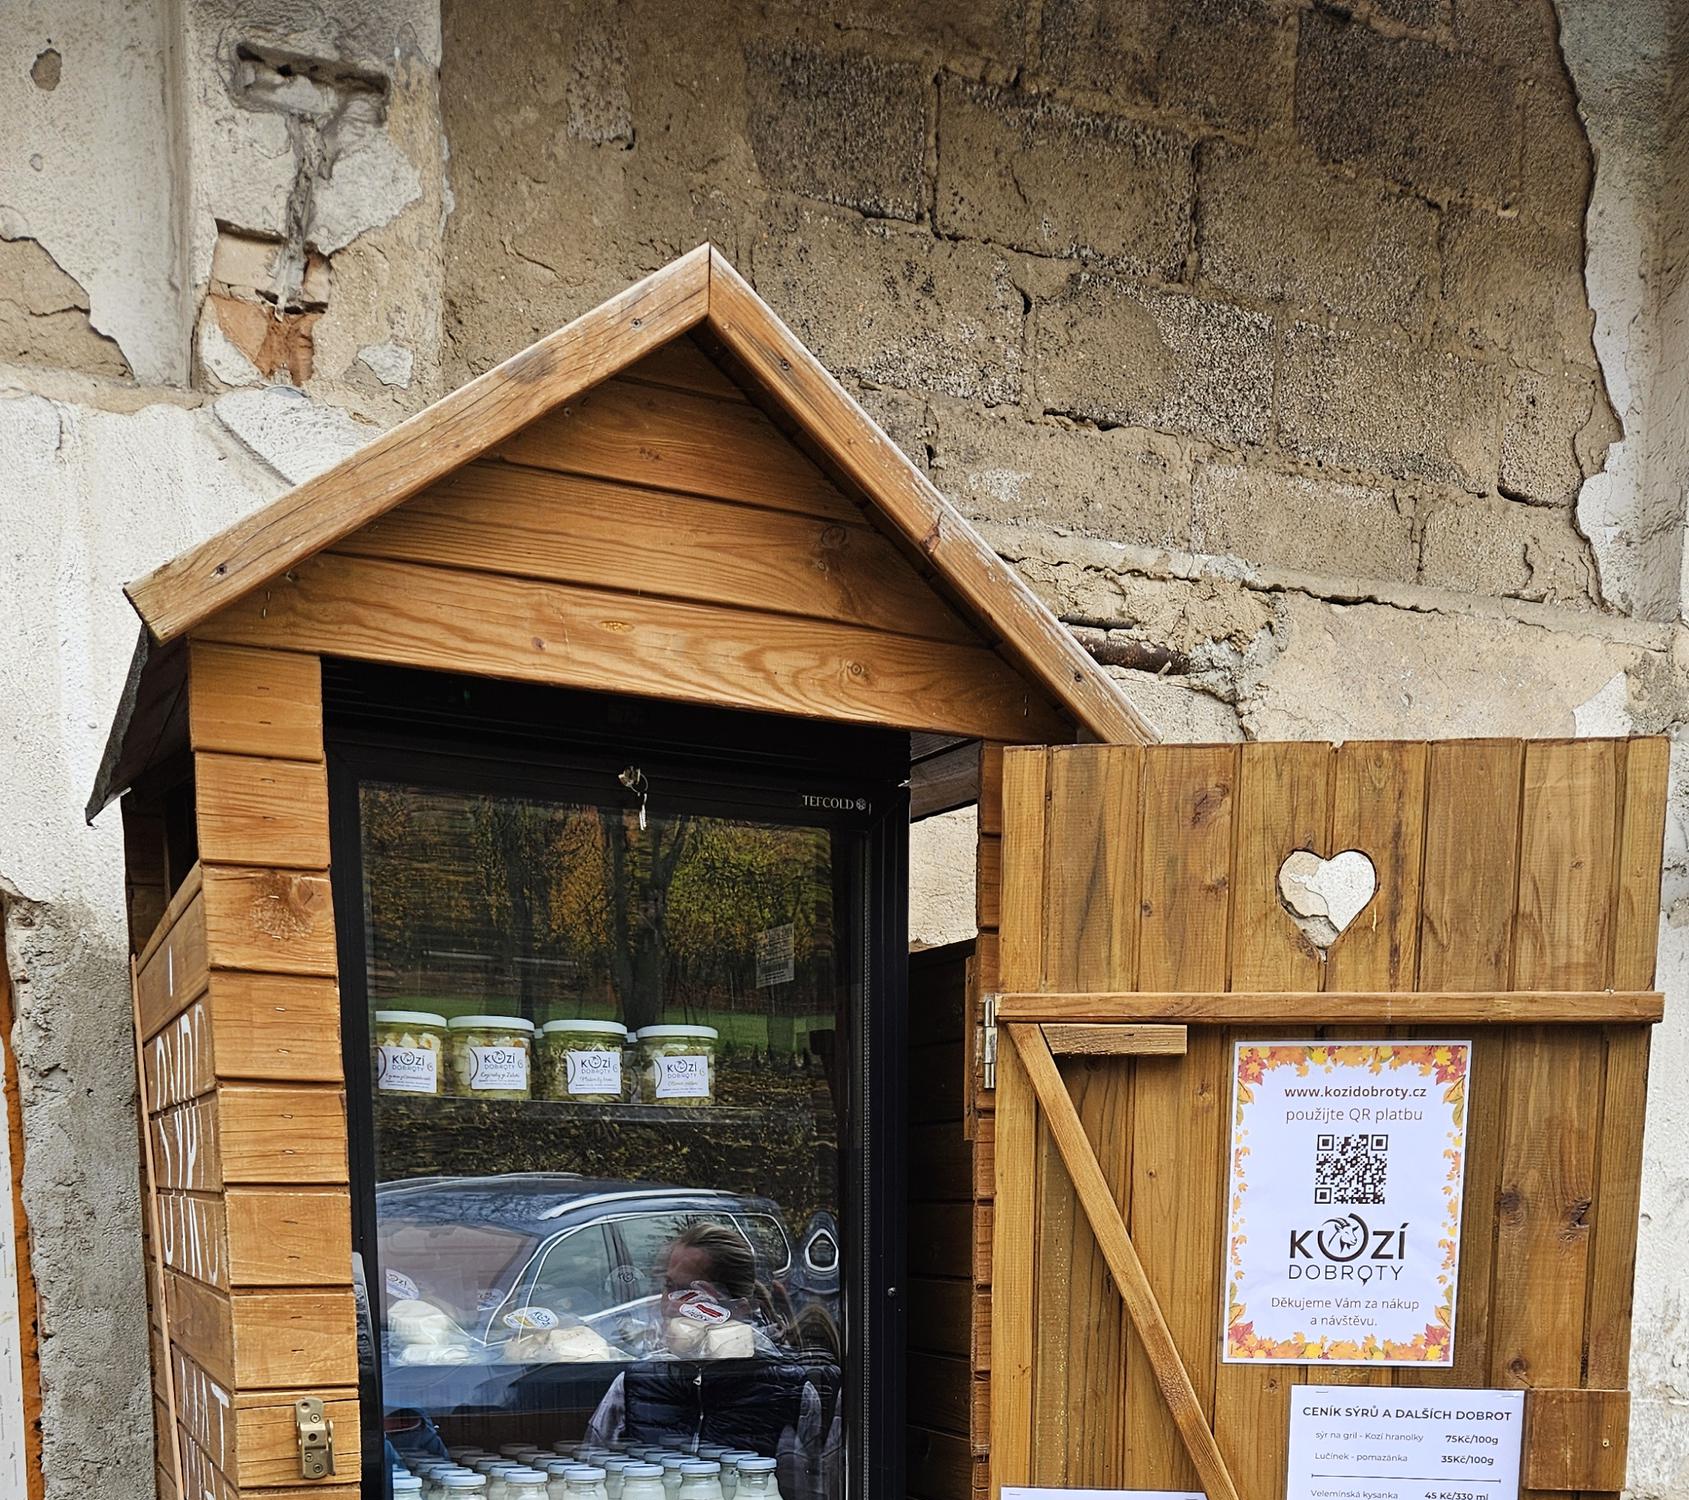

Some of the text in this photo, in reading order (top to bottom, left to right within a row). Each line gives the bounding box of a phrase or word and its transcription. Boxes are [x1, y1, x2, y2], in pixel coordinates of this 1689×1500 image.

[802, 794, 853, 810] TEFCOLD
[393, 1051, 424, 1066] KOZÍ
[484, 1050, 515, 1064] KOZÍ
[581, 1055, 610, 1068] KOZÍ
[667, 1059, 697, 1073] KOZÍ
[1284, 1086, 1427, 1099] www.kozidobroty.cz
[1285, 1108, 1423, 1124] použijte QR platbu
[1289, 1213, 1409, 1263] KOZÍ
[1288, 1265, 1404, 1286] DOBROTY
[1271, 1297, 1419, 1312] Děkujeme Vám za nákup
[1310, 1314, 1377, 1327] a návštěvu.
[1303, 1405, 1512, 1421] CENÍK SÝRŮ A DALŠÍCH DOBROT
[1316, 1432, 1328, 1441] sýr
[1343, 1432, 1358, 1441] gril
[1365, 1432, 1383, 1440] Kozí
[1385, 1433, 1424, 1443] hranolky
[1446, 1434, 1498, 1445] 75Kč/100g
[1315, 1452, 1494, 1466] Lučínek pomazánka 35Kč/100g
[1363, 1492, 1398, 1500] kysanka
[1425, 1492, 1437, 1500] 45
[1440, 1492, 1474, 1500] Kč/330
[1476, 1493, 1489, 1500] ml
